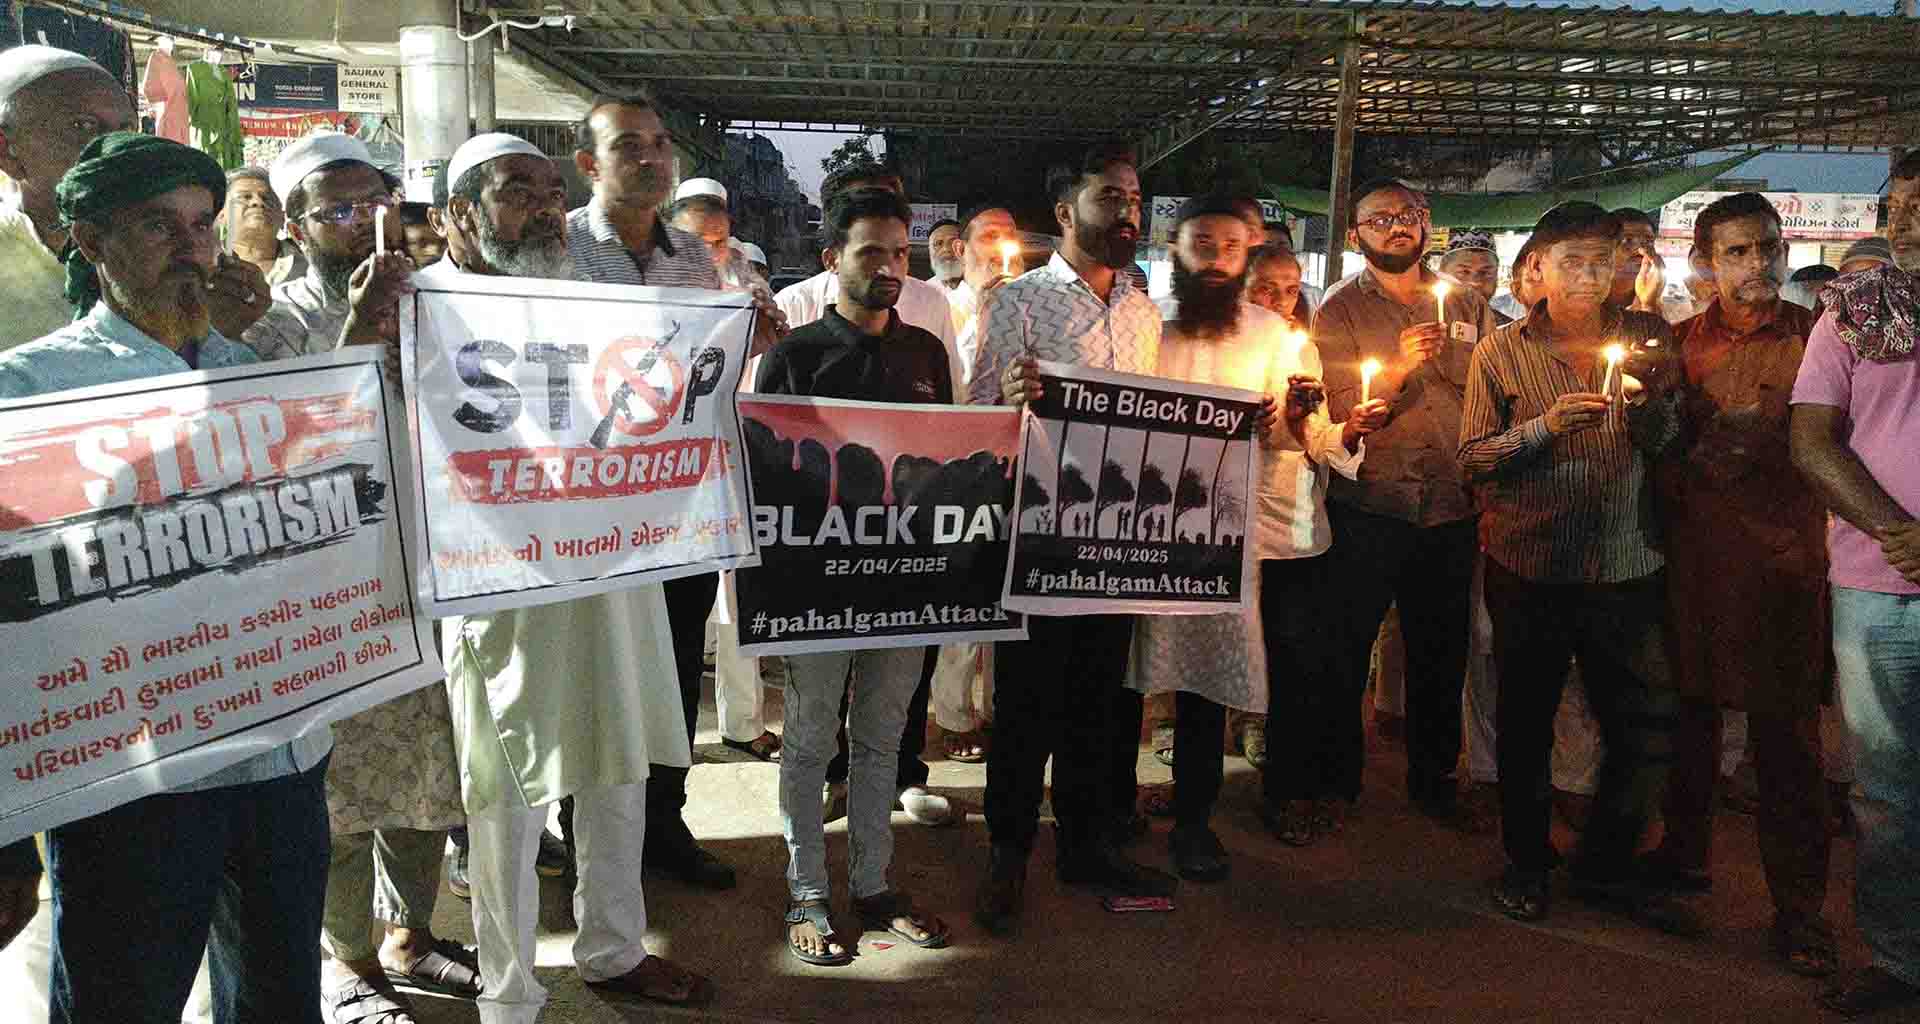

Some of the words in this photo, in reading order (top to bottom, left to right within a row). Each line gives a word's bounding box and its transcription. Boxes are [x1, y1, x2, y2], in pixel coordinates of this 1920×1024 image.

[341, 81, 389, 89] GENERAL
[344, 69, 385, 77] SAURAV
[1060, 382, 1109, 414] The
[1116, 390, 1190, 423] Black
[1195, 400, 1244, 434] Day
[75, 398, 286, 507] STOP
[488, 447, 702, 495] TERRORISM
[32, 472, 360, 606] TERRORISM
[554, 526, 621, 557] ખાતમો
[754, 505, 919, 546] BLACK
[825, 557, 947, 576] 22/04/2025
[1078, 545, 1169, 564] 22/04/2025
[1026, 568, 1231, 596] #pahalgamAttack
[38, 658, 88, 691] અમે
[102, 645, 131, 681] સૌ
[143, 622, 231, 664] ભારતીય
[311, 577, 384, 612] પહલગામ
[751, 603, 1010, 638] #pahalgamAttack
[137, 656, 225, 711] હુમલામાં
[235, 636, 283, 671] માર્યા
[292, 626, 343, 656] ગયેલા
[351, 603, 408, 633] લોકોના
[13, 716, 183, 783] પરિવારજનોના
[272, 654, 348, 698] સહભાગી
[354, 638, 398, 669] છીએ.
